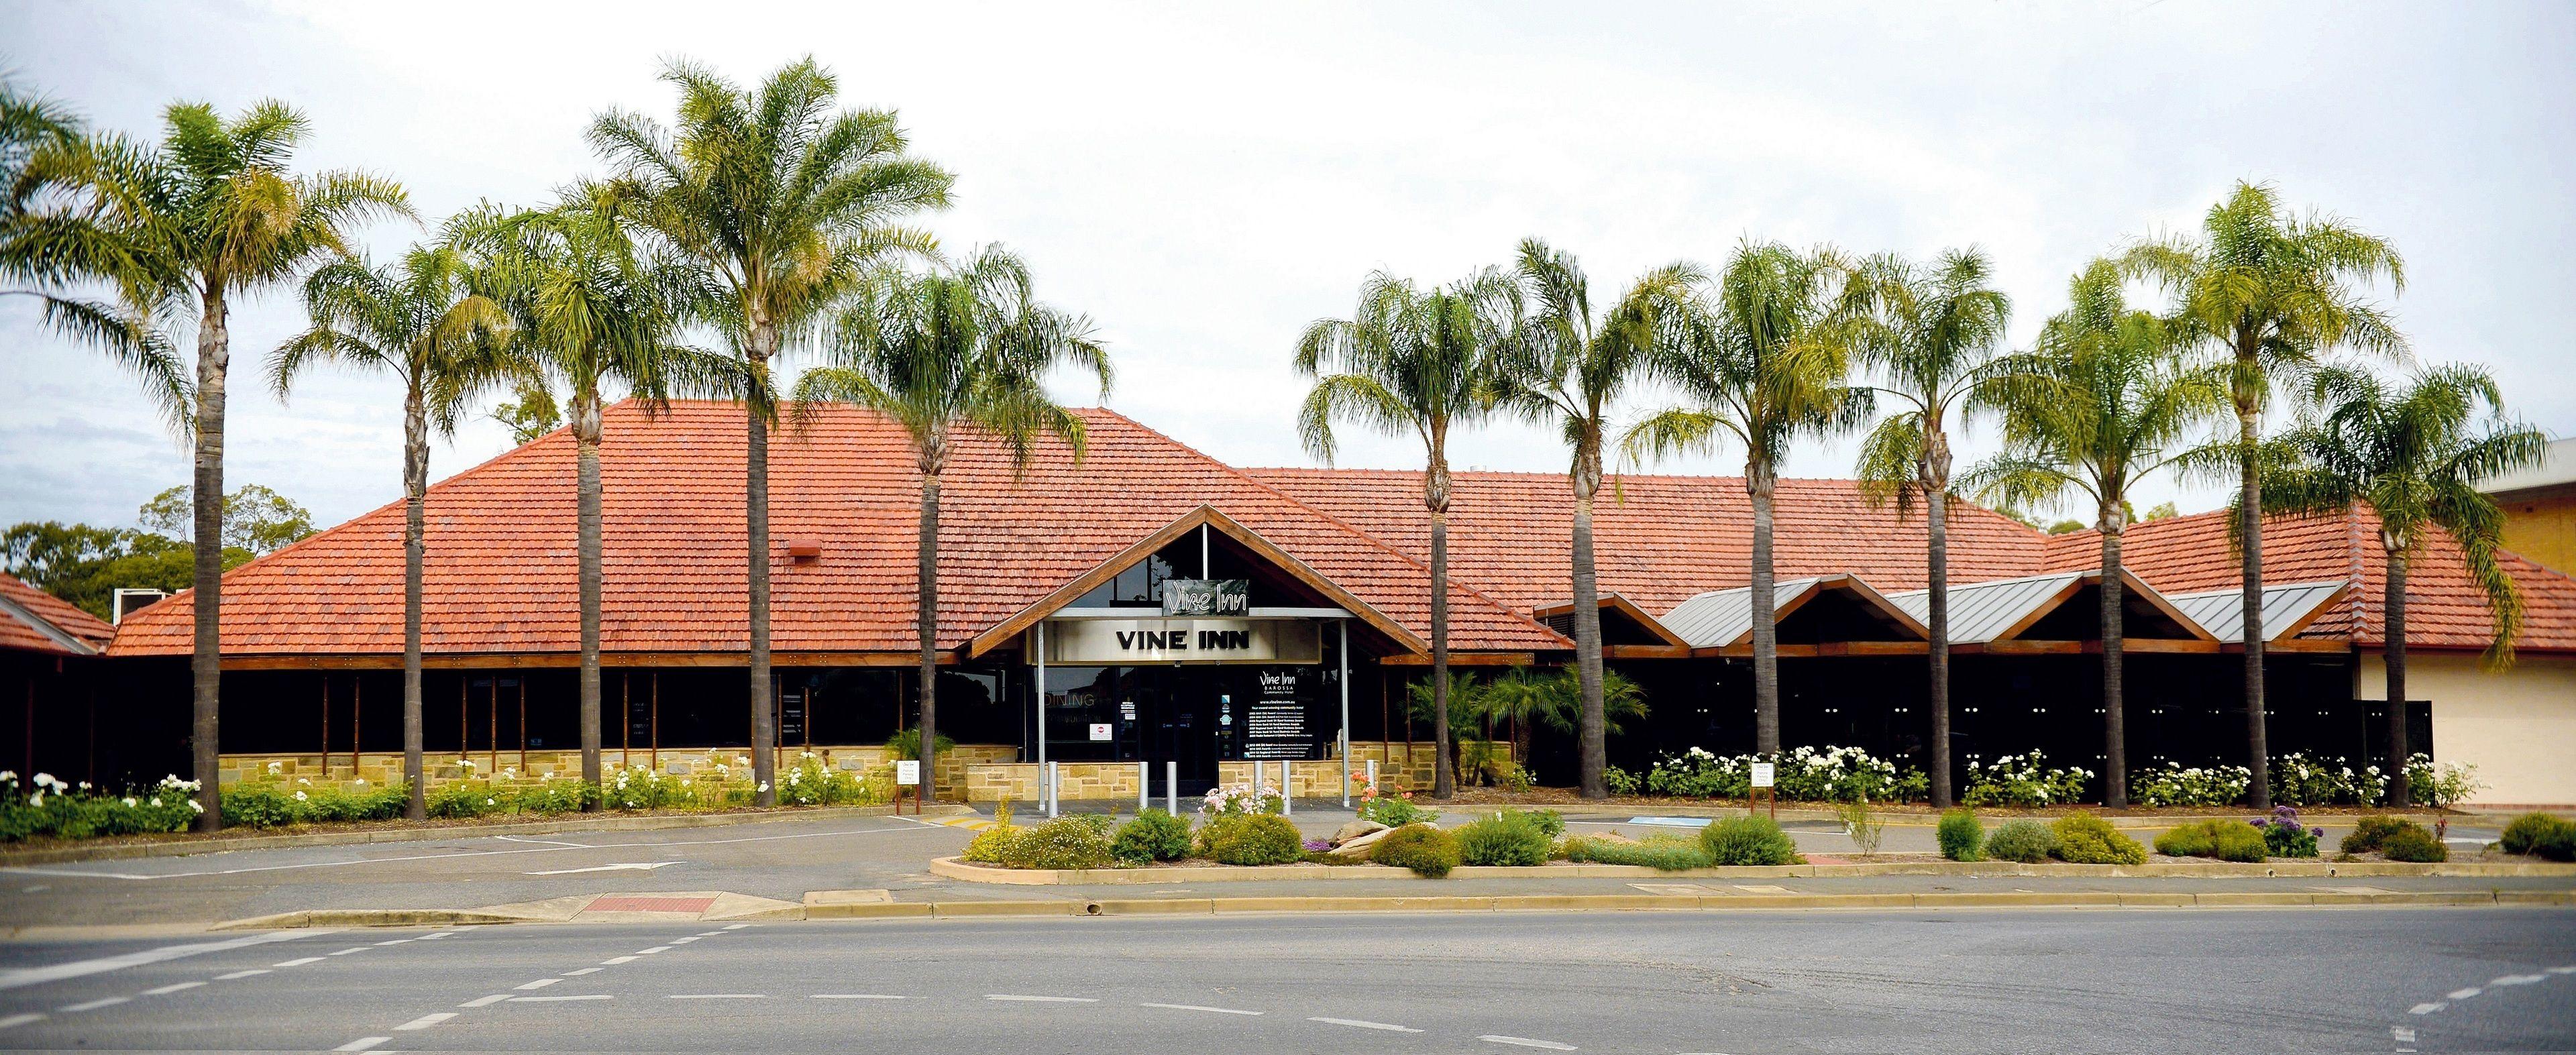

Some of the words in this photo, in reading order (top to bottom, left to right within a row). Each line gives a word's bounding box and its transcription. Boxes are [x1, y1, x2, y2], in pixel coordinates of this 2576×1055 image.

[1166, 581, 1210, 613] Vine
[1217, 584, 1246, 612] Inn
[1116, 630, 1187, 649] VINE
[1198, 630, 1249, 649] INN
[1260, 671, 1280, 685] Vine
[1282, 671, 1295, 685] Inn
[1044, 694, 1095, 706] DINING
